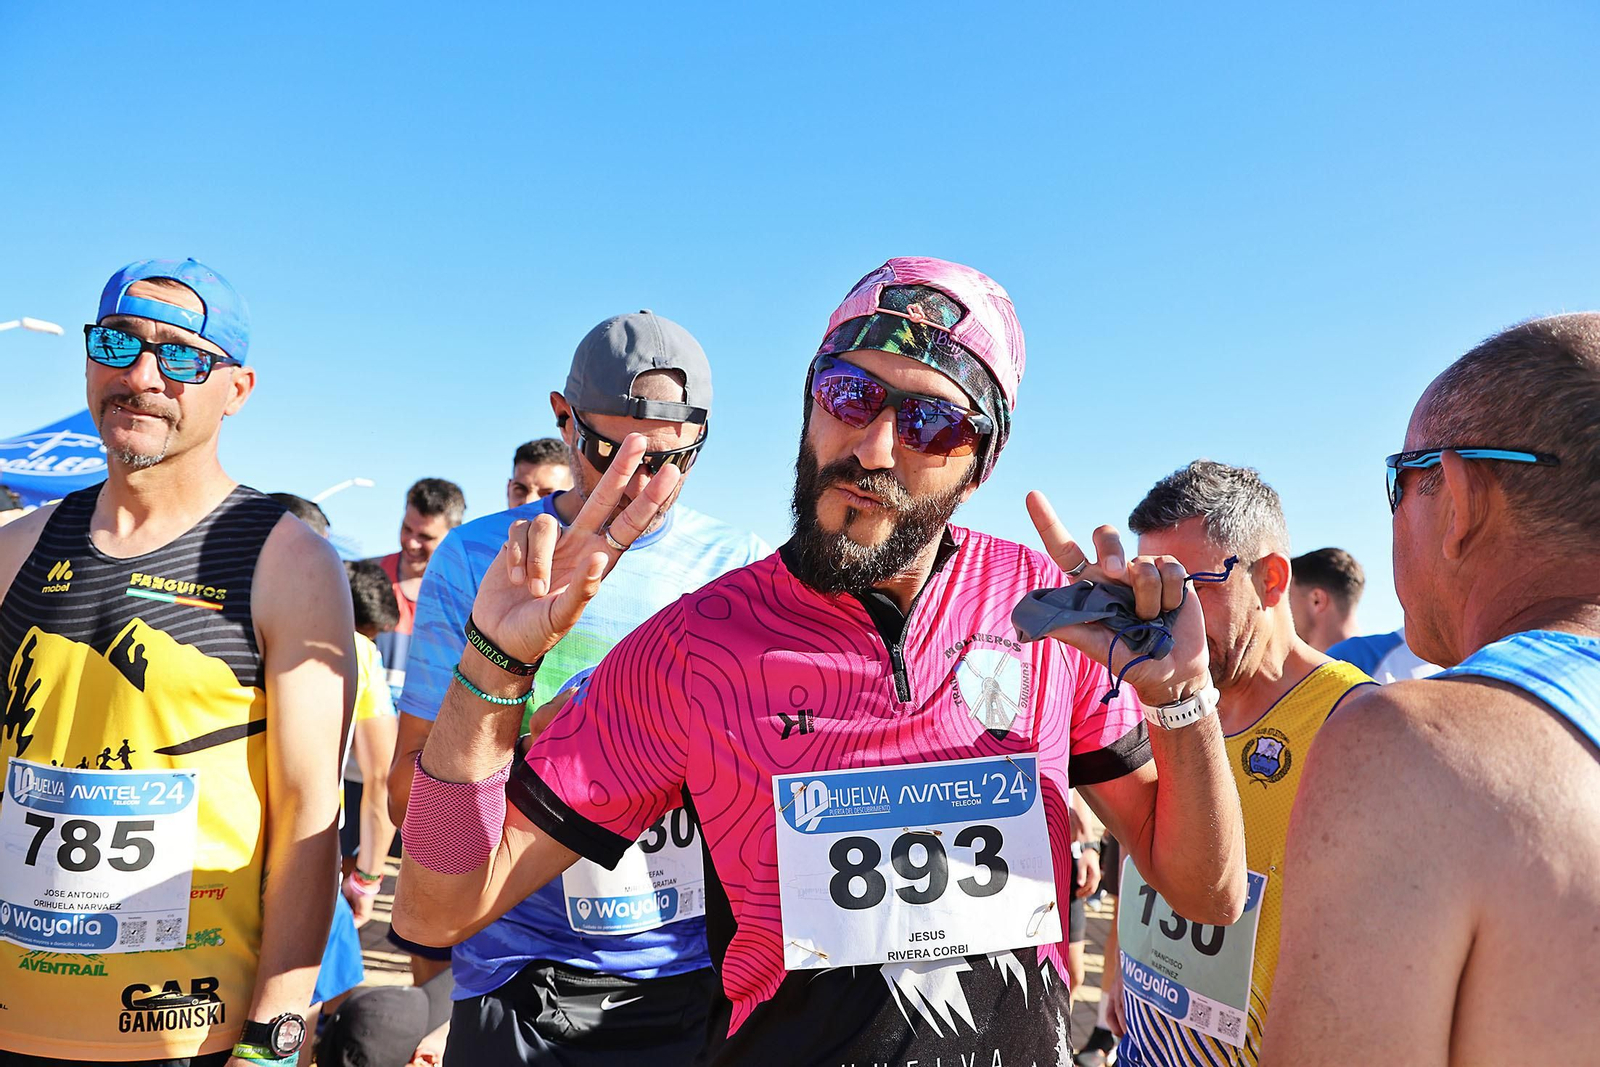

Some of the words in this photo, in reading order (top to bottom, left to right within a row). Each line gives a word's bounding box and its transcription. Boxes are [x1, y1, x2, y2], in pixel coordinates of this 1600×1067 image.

[41, 583, 71, 593] mobel
[129, 572, 227, 600] FANGUITOS
[468, 629, 511, 669] SONRISA
[944, 633, 1022, 659] MOLINEROS
[1020, 662, 1029, 708] RUNNING
[32, 780, 65, 797] HUELVA
[70, 785, 141, 800] AVATEL
[828, 785, 890, 808] HUELVA
[898, 780, 981, 804] AVATEL
[829, 808, 846, 816] PUERTA
[951, 799, 982, 807] TELECOM
[24, 812, 155, 872] 785
[647, 870, 664, 879] EFAN
[828, 824, 1010, 910] 893
[44, 889, 66, 898] JOSE
[67, 891, 110, 899] ANTONIO
[653, 878, 677, 889] GRATIAN
[33, 899, 75, 910] ORIHUELA
[77, 903, 122, 911] NARVAEZ
[595, 891, 670, 920] Wayalia
[13, 908, 102, 937] Wayalia
[1138, 884, 1225, 957] 130
[908, 930, 946, 943] JESUS
[887, 949, 931, 961] RIVERA
[932, 944, 969, 958] CORBI
[1151, 949, 1183, 970] FRANCISCO
[18, 957, 109, 977] AVENTRAIL
[1125, 957, 1179, 1004] Wayalia
[118, 1003, 226, 1033] GAMONSKI
